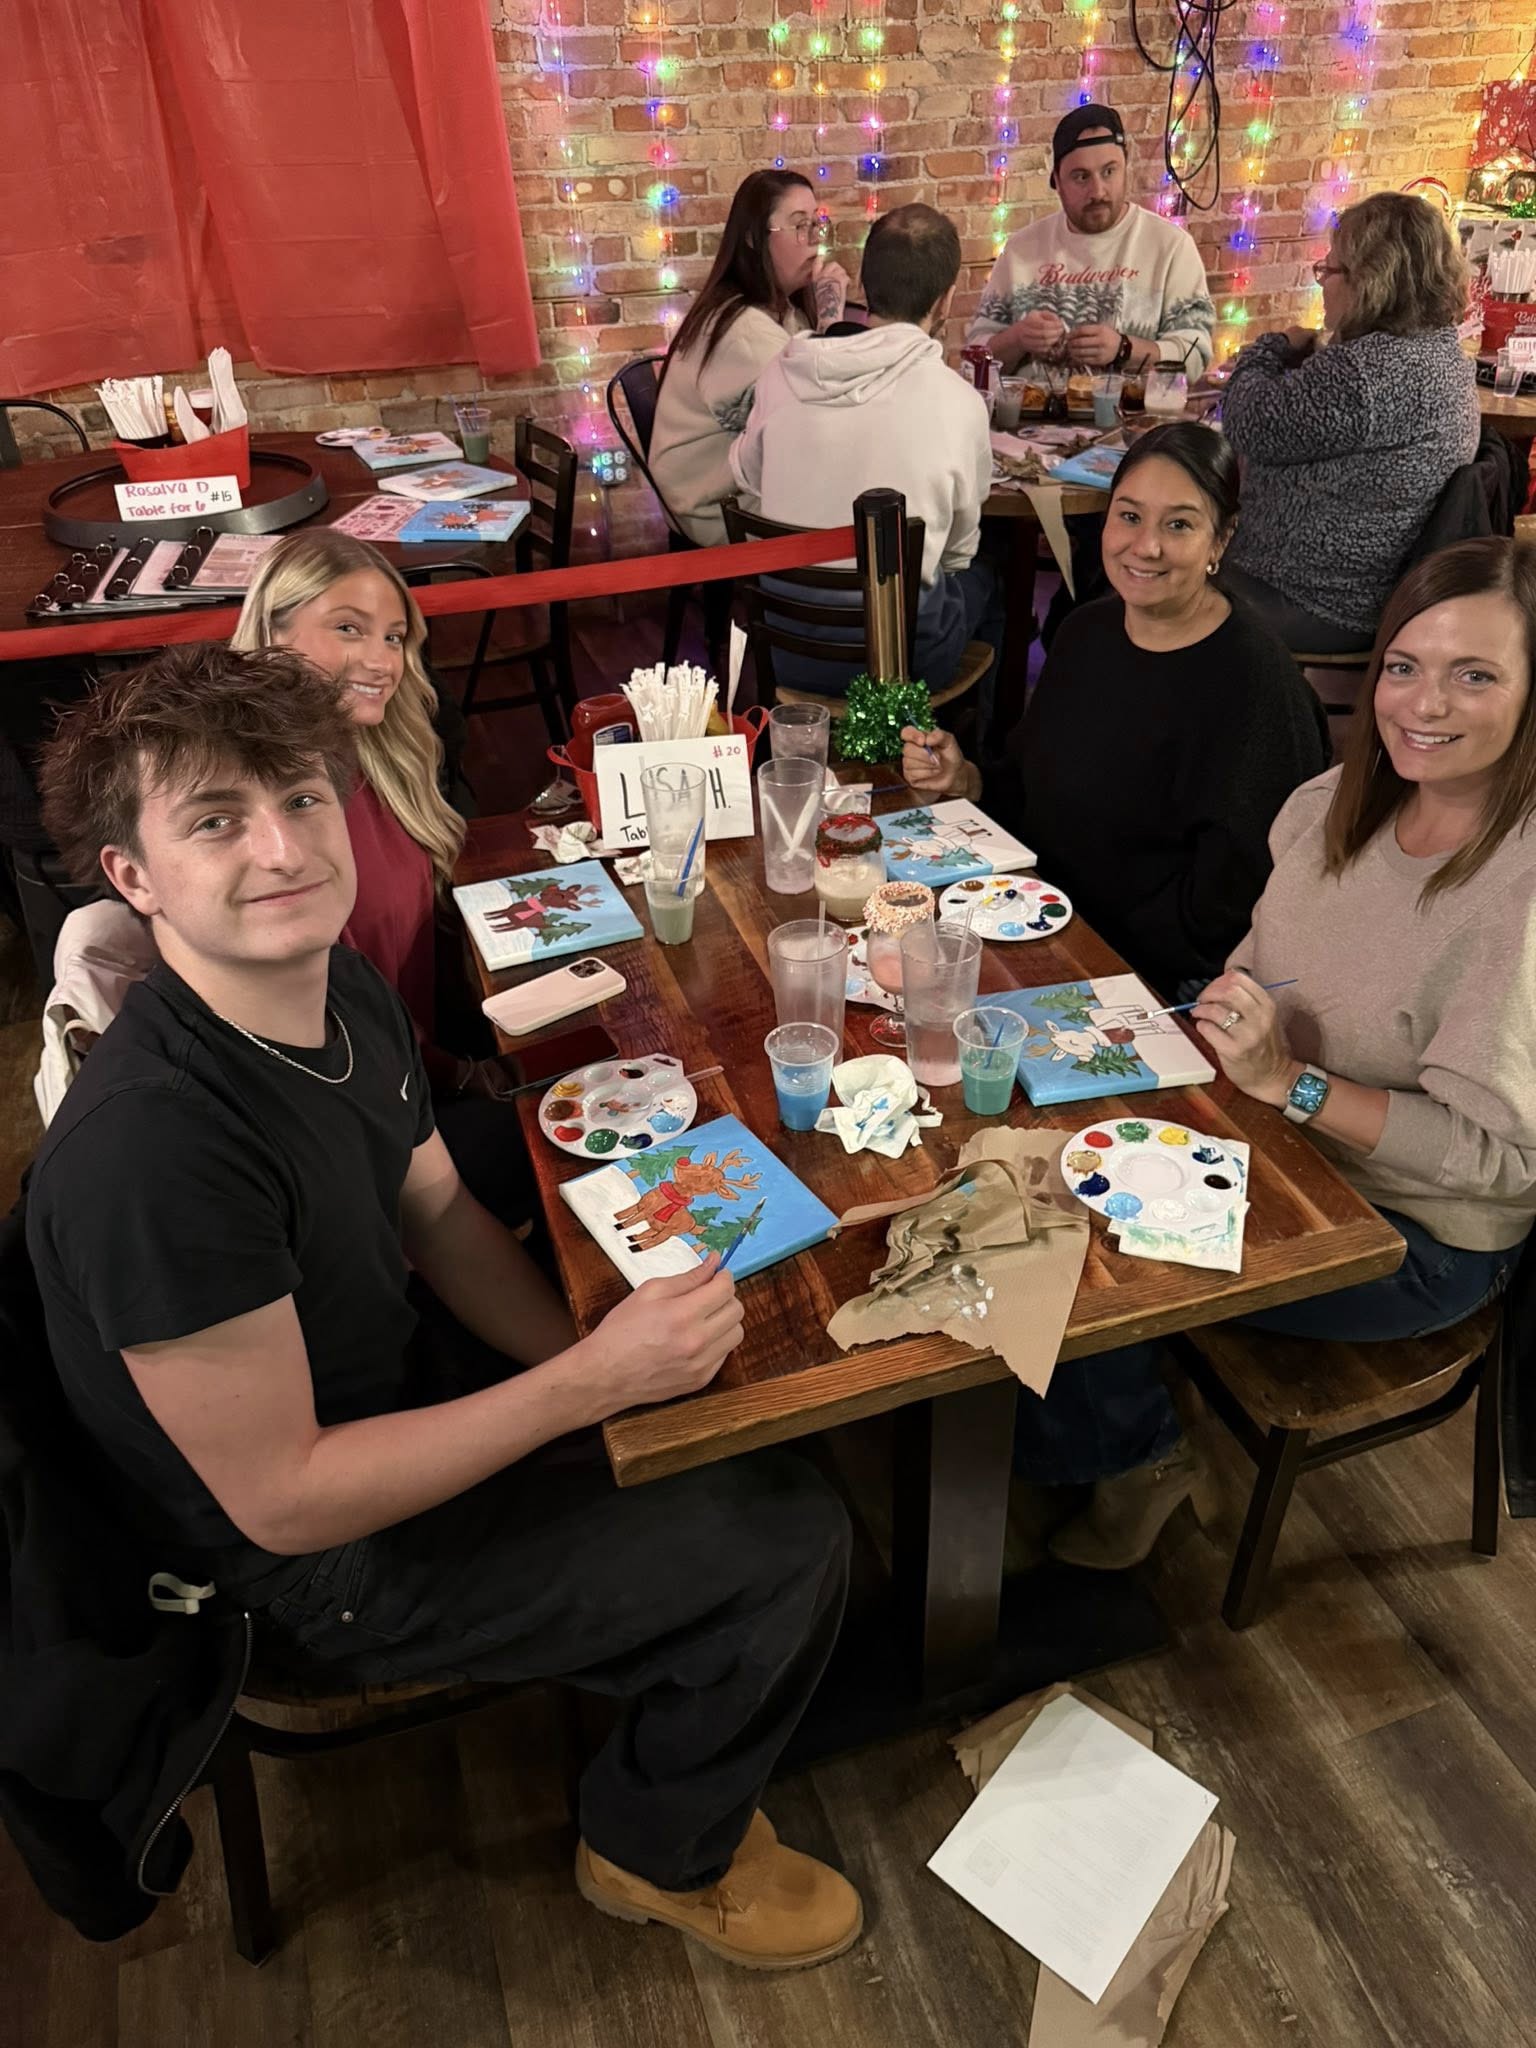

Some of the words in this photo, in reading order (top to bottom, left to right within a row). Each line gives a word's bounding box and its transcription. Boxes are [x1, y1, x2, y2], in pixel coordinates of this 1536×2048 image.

[125, 482, 188, 498] Rosalva
[196, 481, 209, 493] D
[126, 505, 166, 518] Table
[171, 503, 191, 514] for
[195, 500, 206, 512] 6
[619, 825, 649, 842] Tab
